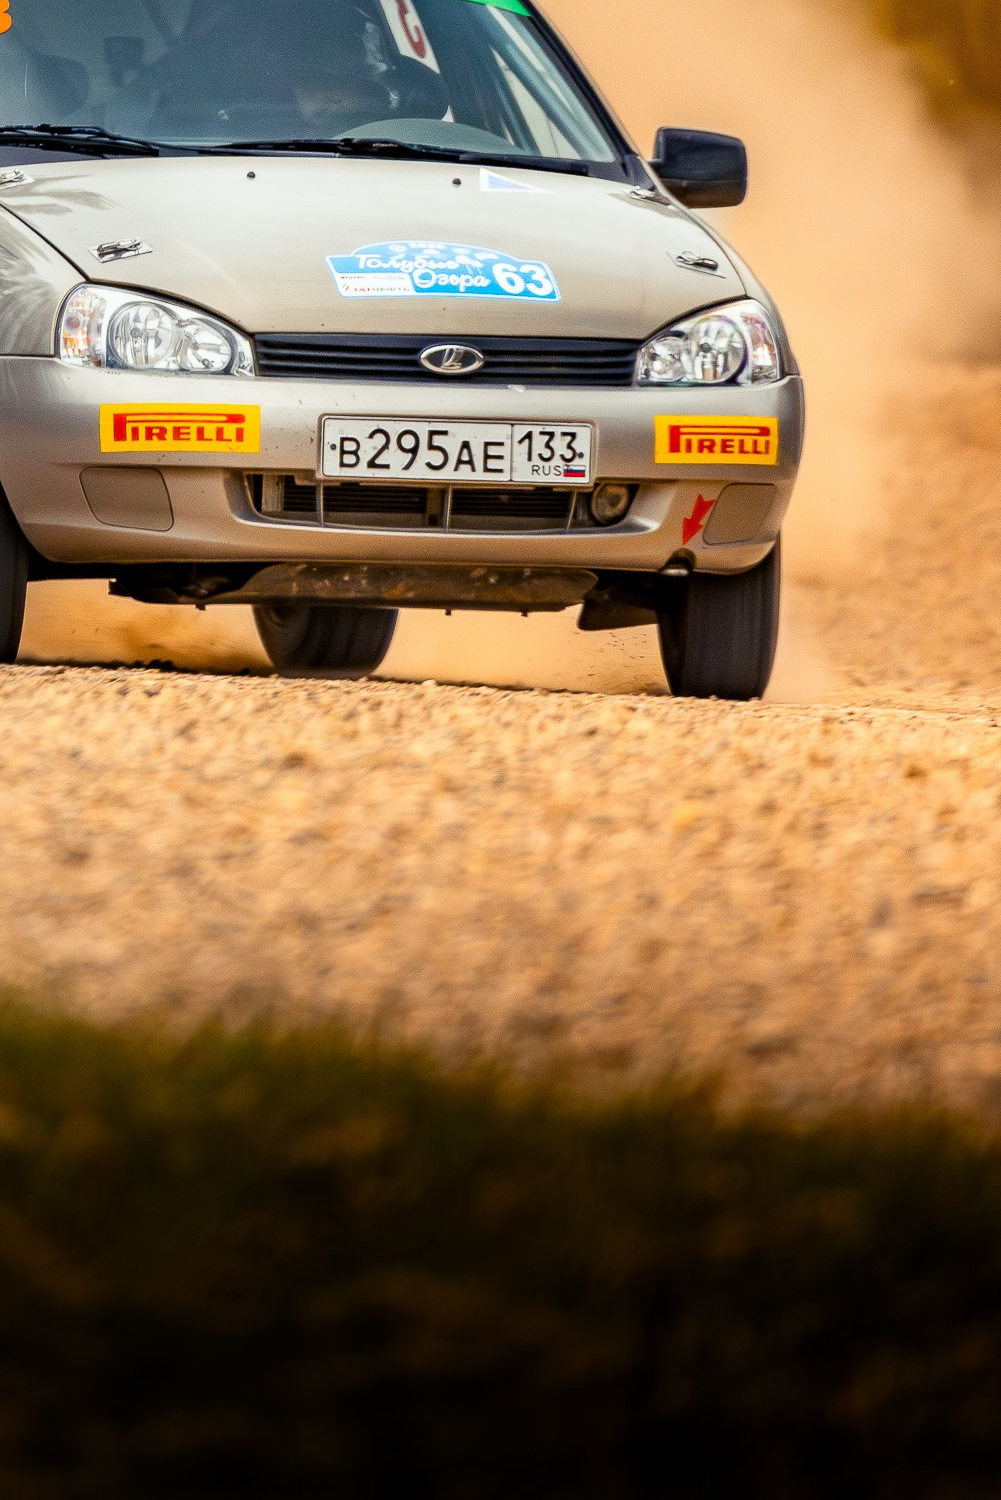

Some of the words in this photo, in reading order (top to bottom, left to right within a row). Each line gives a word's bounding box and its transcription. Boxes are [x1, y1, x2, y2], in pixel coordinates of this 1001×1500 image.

[492, 262, 555, 297] 63
[113, 412, 246, 443] PIRELLI
[668, 424, 770, 455] PIRELLI
[517, 430, 578, 463] 133
[531, 464, 562, 476] RUS
